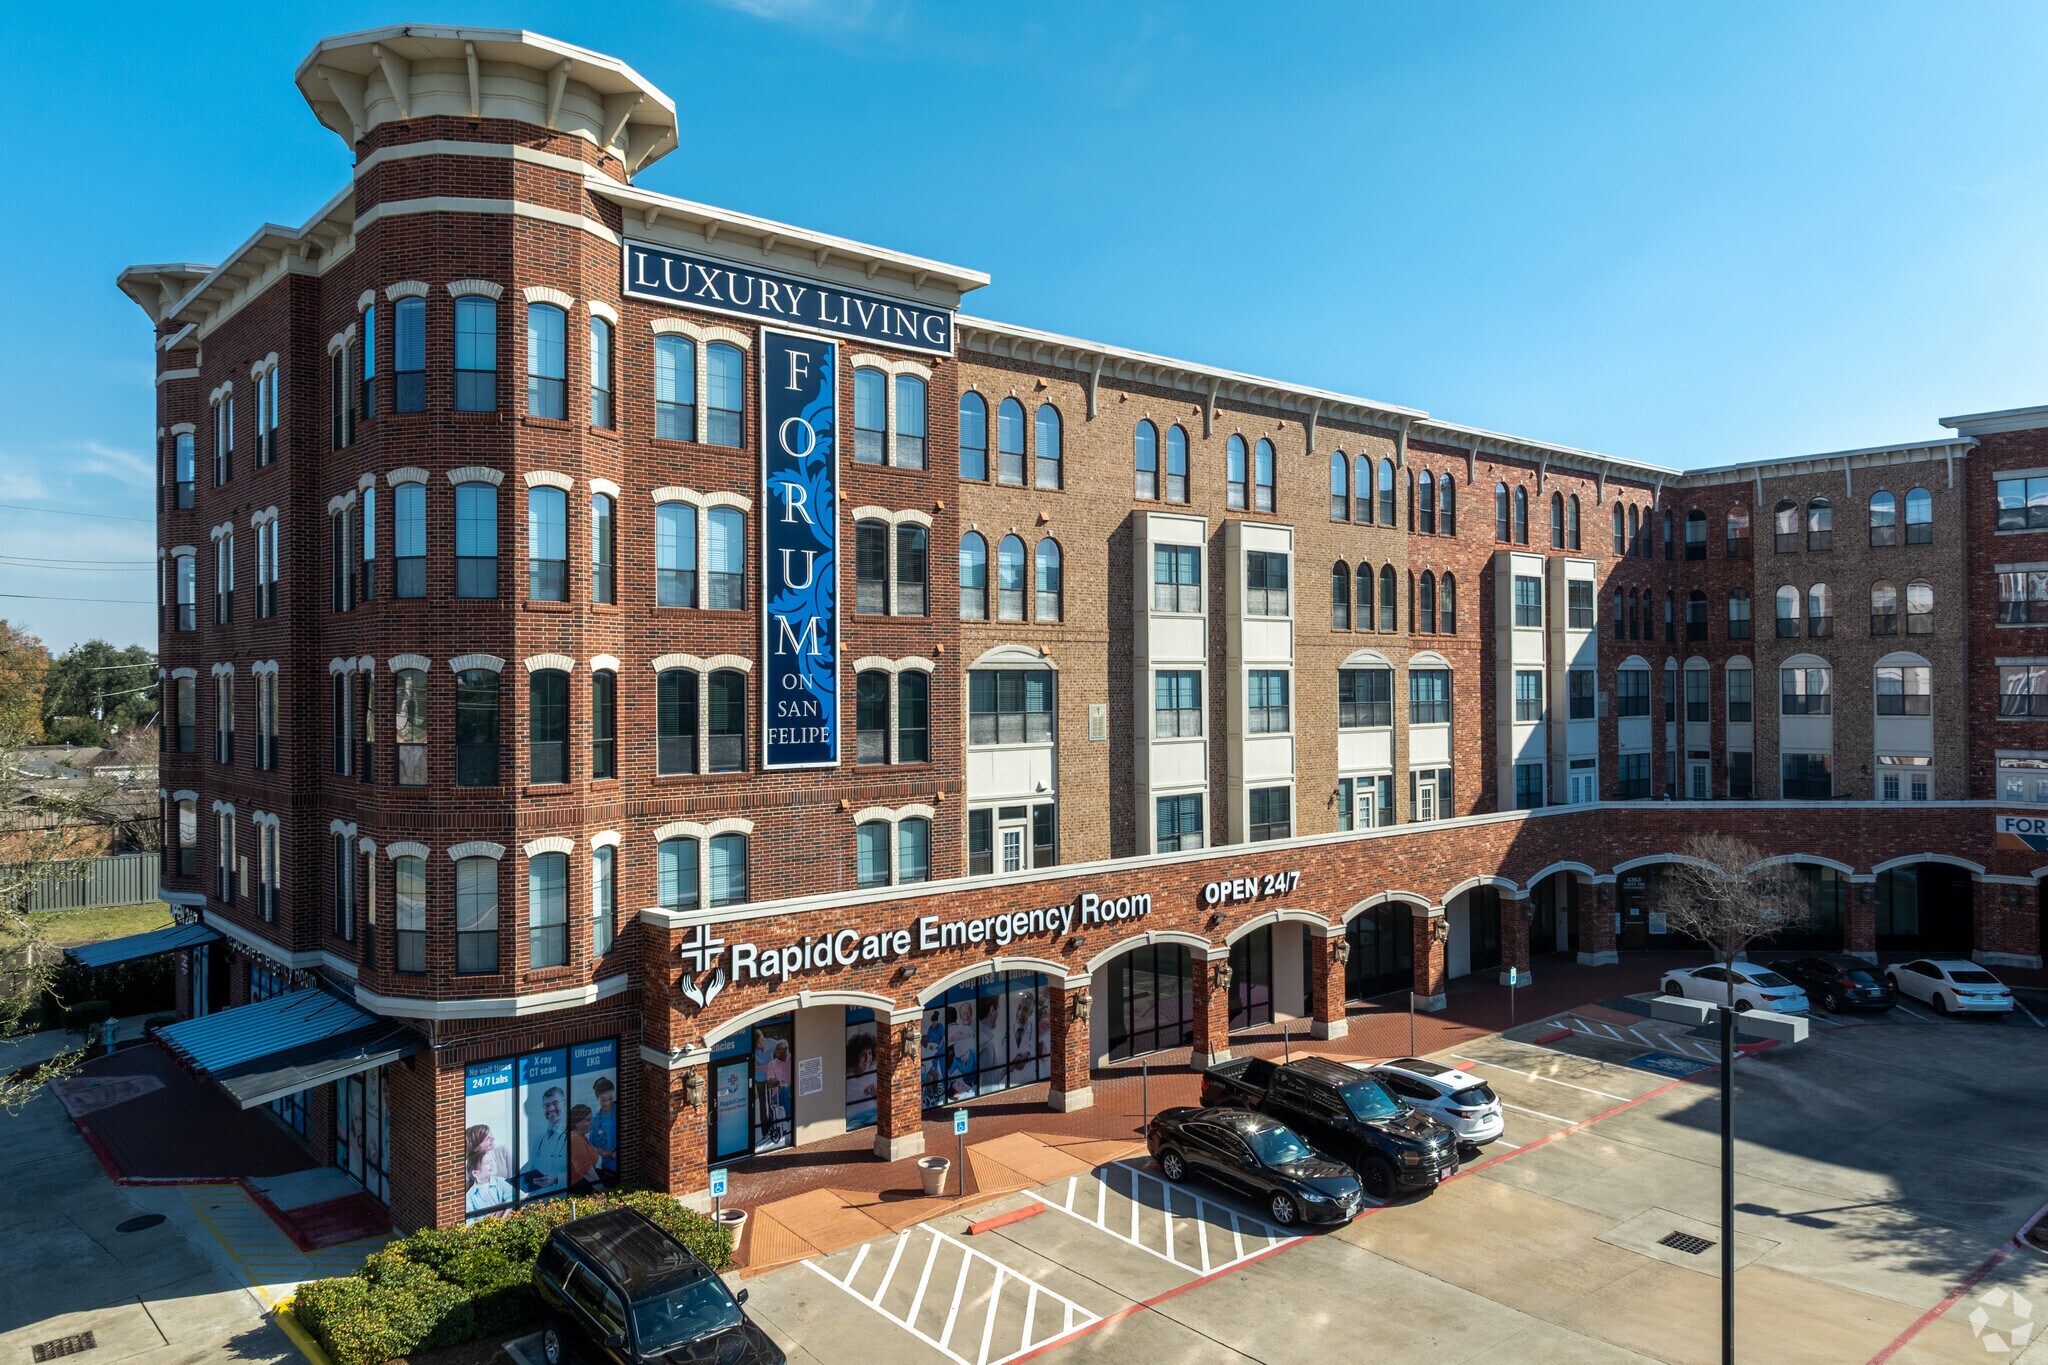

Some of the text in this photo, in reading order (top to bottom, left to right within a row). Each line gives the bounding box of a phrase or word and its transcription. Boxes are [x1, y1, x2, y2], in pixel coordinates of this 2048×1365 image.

[634, 252, 946, 344] LUXURY LIVING
[774, 349, 823, 656] FORUM
[782, 673, 813, 690] ON
[777, 700, 818, 718] SAN
[768, 726, 830, 745] FELIPE
[2005, 818, 2047, 834] FOR
[1205, 871, 1300, 904] OPEN 24/7
[732, 893, 1152, 982] RapidCare Emergency Room
[574, 1043, 612, 1059] Ultrasound
[534, 1056, 553, 1066] X-ray
[586, 1056, 601, 1067] EKG
[469, 1067, 478, 1077] No
[479, 1065, 493, 1075] wait
[529, 1066, 557, 1078] CT scan
[472, 1074, 509, 1089] 24/7 Labs
